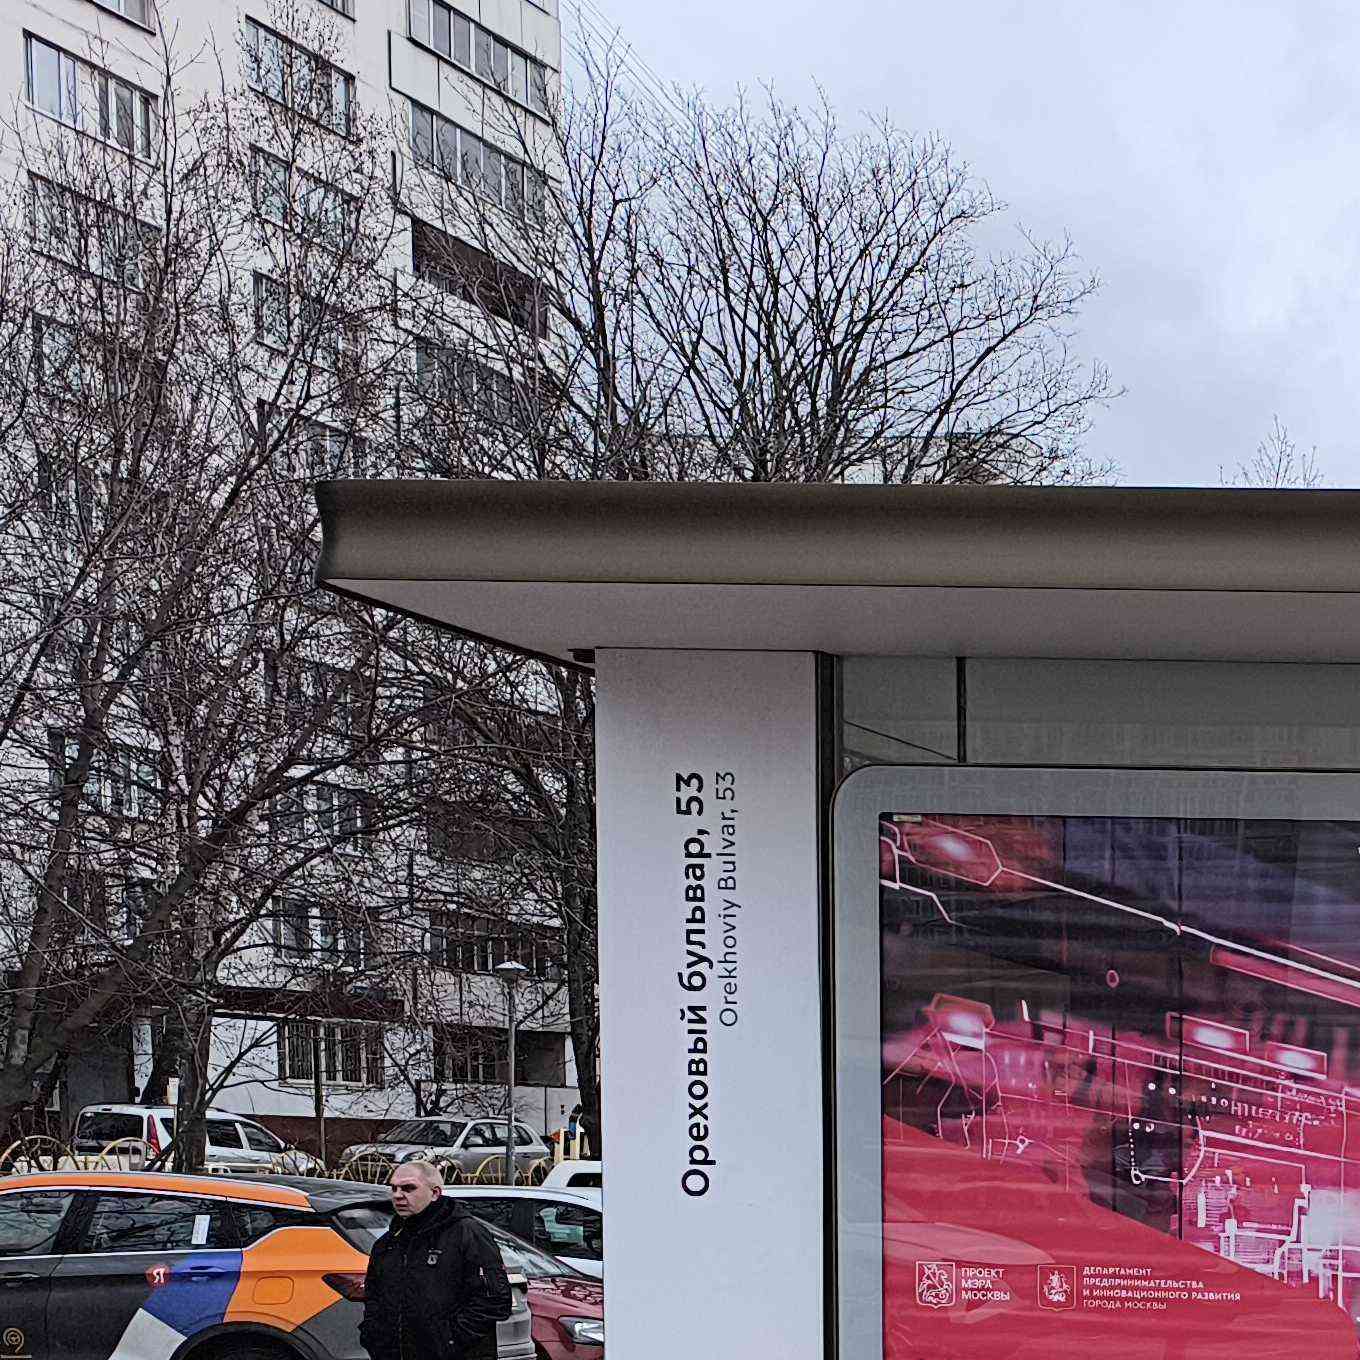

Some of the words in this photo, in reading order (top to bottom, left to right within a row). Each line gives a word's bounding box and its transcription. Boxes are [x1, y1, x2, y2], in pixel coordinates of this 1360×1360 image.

[715, 771, 735, 801] 53
[675, 771, 705, 817] 53
[716, 810, 739, 892] Bulvar,
[678, 827, 714, 992] бульвар,
[718, 903, 742, 1027] Orekhoviy
[680, 1004, 716, 1197] Ореховый
[961, 1267, 1004, 1278] ПРОЕКТ
[1083, 1266, 1152, 1277] ДЕПАРТАМЕНТ
[961, 1279, 992, 1290] МЭРА
[1083, 1278, 1204, 1289] ПРЕДПРИНИМАТЕЛЬСТВА
[961, 1290, 1010, 1302] МОСКВЫ
[1083, 1289, 1089, 1298] И
[1093, 1289, 1188, 1301] ИННОВАЦИОННОГО
[1192, 1292, 1240, 1302] РАЗВИТИЯ
[1083, 1299, 1120, 1310] ГОРОДА
[1124, 1301, 1166, 1310] МОСКВЫ
